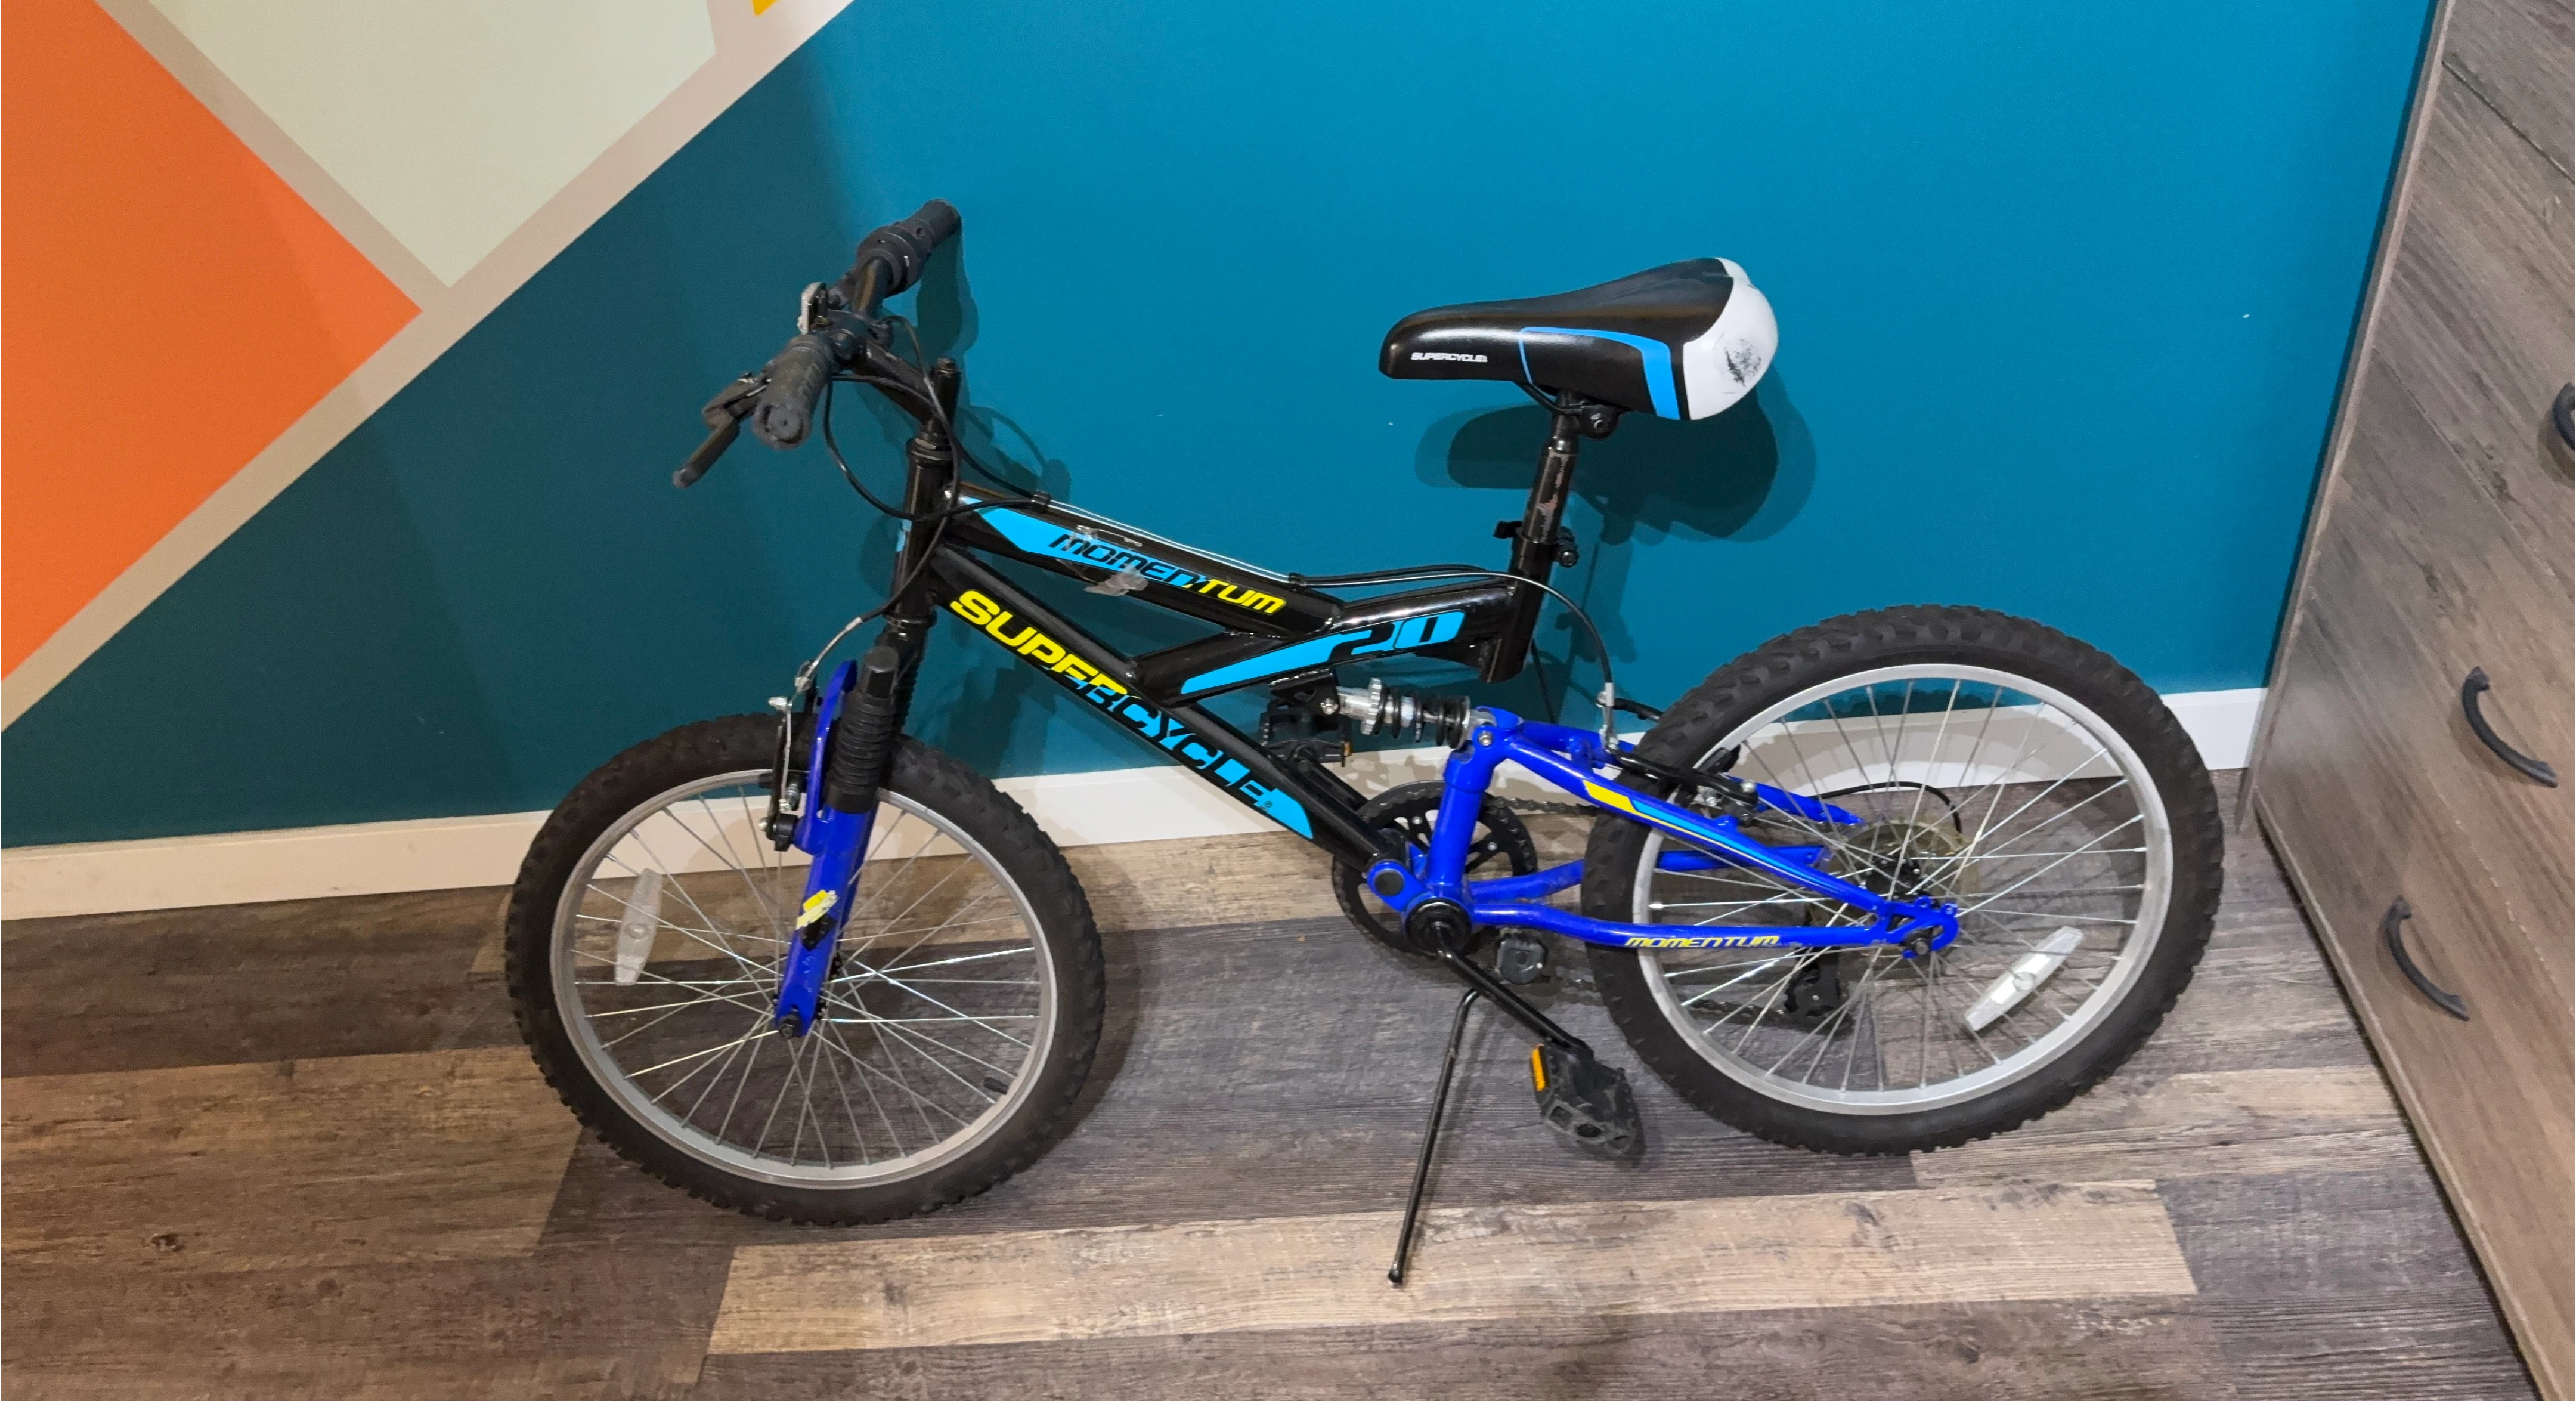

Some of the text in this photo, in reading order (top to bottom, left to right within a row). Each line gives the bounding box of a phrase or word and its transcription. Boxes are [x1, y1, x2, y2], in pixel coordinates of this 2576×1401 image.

[1049, 533, 1287, 614] MOMENTUM
[1327, 610, 1466, 661] 20
[950, 589, 1272, 808] SUPERCYCLE
[1624, 935, 1780, 947] MOMENTUM
